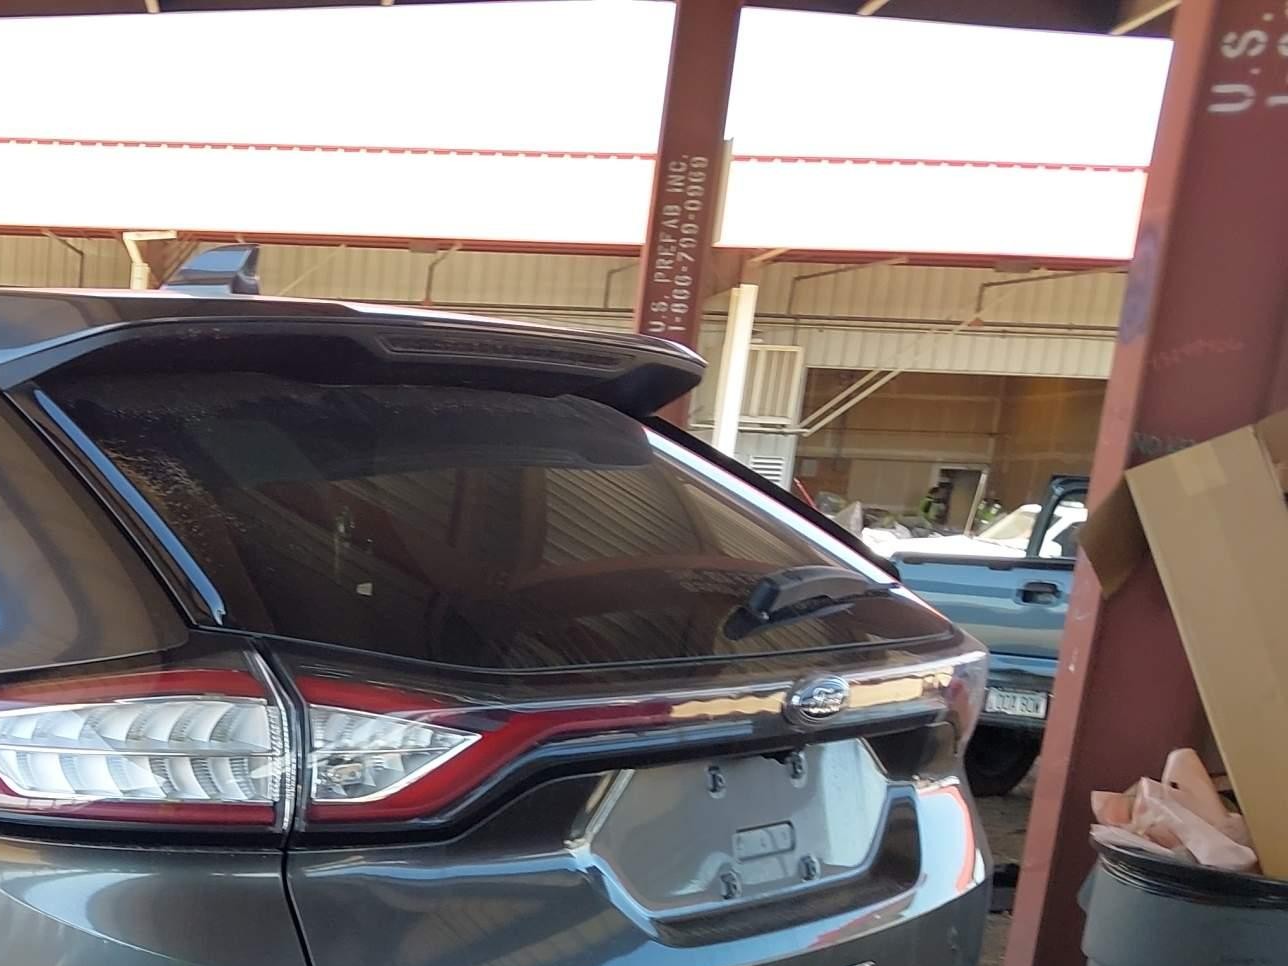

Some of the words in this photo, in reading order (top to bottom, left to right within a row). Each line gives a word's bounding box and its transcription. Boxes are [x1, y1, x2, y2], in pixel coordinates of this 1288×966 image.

[1207, 12, 1274, 114] U.S.
[665, 153, 689, 194] INC.
[653, 203, 682, 284] PREFAB
